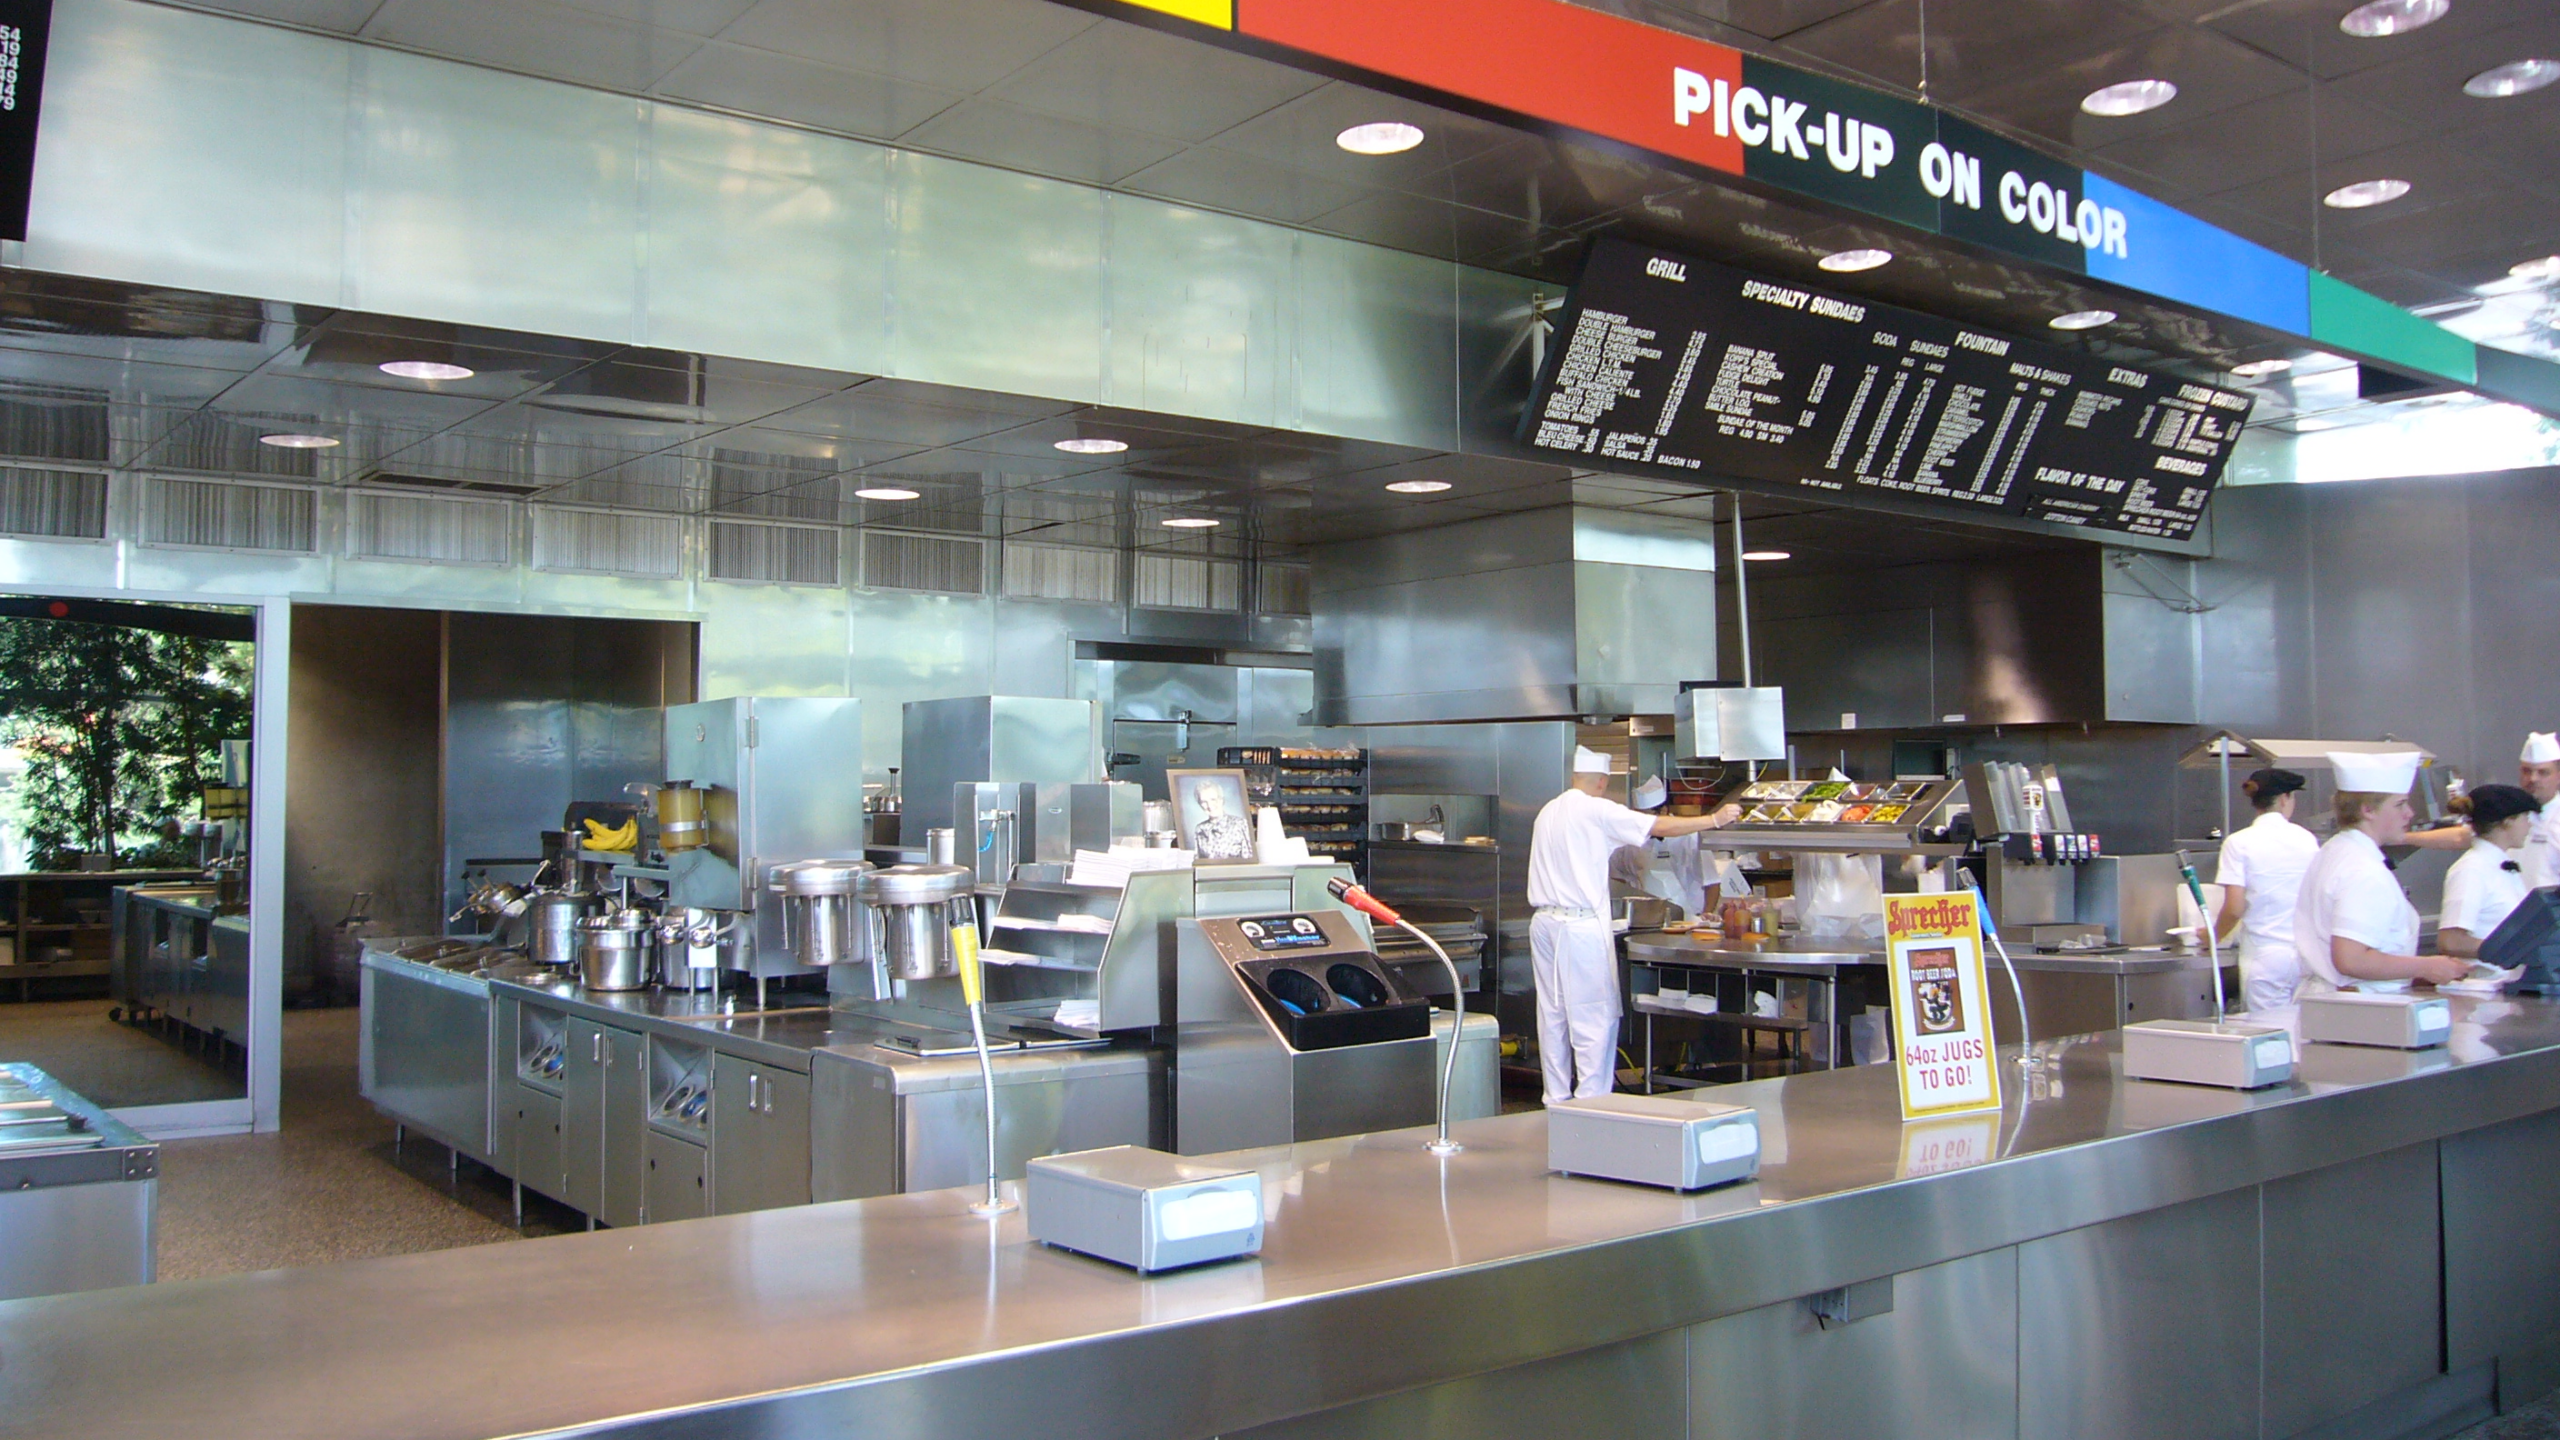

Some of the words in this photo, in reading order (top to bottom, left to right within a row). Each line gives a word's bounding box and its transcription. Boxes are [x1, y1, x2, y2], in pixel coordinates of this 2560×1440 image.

[1673, 67, 1894, 179] PICK-UP
[1919, 142, 1981, 210] ON
[1999, 170, 2128, 259] COLOR
[1646, 258, 1686, 282] GRILL
[1742, 281, 1809, 309] SPECIALTY
[1810, 296, 1865, 322] SUNDAES
[1582, 308, 1628, 325] HAMBURGER
[1575, 325, 1606, 339] CHEESE
[1607, 331, 1638, 345] BURGER
[1578, 316, 1609, 331] DOUBLE
[1610, 323, 1656, 339] HAMBURGER
[1571, 334, 1603, 348] DOUBLE
[1604, 340, 1662, 359] CHEESEBURGER
[1873, 332, 1897, 346] SODA
[1910, 340, 1949, 358] SUNDAES
[1955, 332, 2009, 355] FOUNTAIN
[1566, 351, 1601, 365] CHICKEN
[1569, 343, 1601, 356] GRILLED
[1602, 349, 1636, 363] CHICKEN
[1563, 359, 1598, 373] CHICKEN
[1721, 360, 1751, 374] CASHEW
[1751, 366, 1784, 380] CREATION
[2010, 363, 2035, 377] MALTS
[2033, 368, 2042, 379] &
[2041, 369, 2071, 385] SHAKES
[1556, 375, 1575, 387] FISH
[1559, 368, 1594, 381] BUFFALO
[1595, 374, 1629, 387] CHICKEN
[1715, 377, 1740, 389] TURTLE
[1717, 368, 1741, 381] FUDGE
[1741, 373, 1770, 386] DELIGHT
[2108, 368, 2148, 388] EXTRAS
[1550, 392, 1583, 405] GRILLED
[1584, 398, 1615, 410] CHEESE
[1564, 386, 1584, 397] WITH
[1585, 390, 1616, 402] CHEESE
[1708, 393, 1735, 405] BUTTER
[1735, 397, 1751, 408] LOG
[1711, 384, 1752, 400] CHOCOLATE
[2178, 384, 2214, 403] FROZEN
[2210, 392, 2249, 411] CUSTARD
[1544, 408, 1570, 420] ONION
[1571, 413, 1595, 424] RINGS
[1547, 400, 1579, 413] FRENCH
[1579, 405, 1602, 417] FRIES
[1541, 421, 1579, 434] TOMATOES
[1717, 414, 1745, 427] SUNDAE
[1745, 419, 1757, 428] OF
[1756, 420, 1770, 431] THE
[1769, 423, 1794, 434] MONTH
[1718, 425, 1735, 435] REG
[1534, 436, 1551, 447] HOT
[1600, 446, 1617, 456] HOT
[1657, 454, 1686, 466] BACON
[2155, 456, 2207, 476] BEVERAGES
[2035, 467, 2071, 484] FLAVOR
[2071, 473, 2087, 486] OF
[2086, 475, 2106, 490] THE
[2104, 479, 2125, 493] DAY
[1888, 899, 1971, 938] Sprecher
[1906, 1045, 1938, 1066] 64oz
[1942, 1039, 1983, 1062] JUGS
[1919, 1069, 1939, 1090] TO
[1944, 1065, 1972, 1087] GO!
